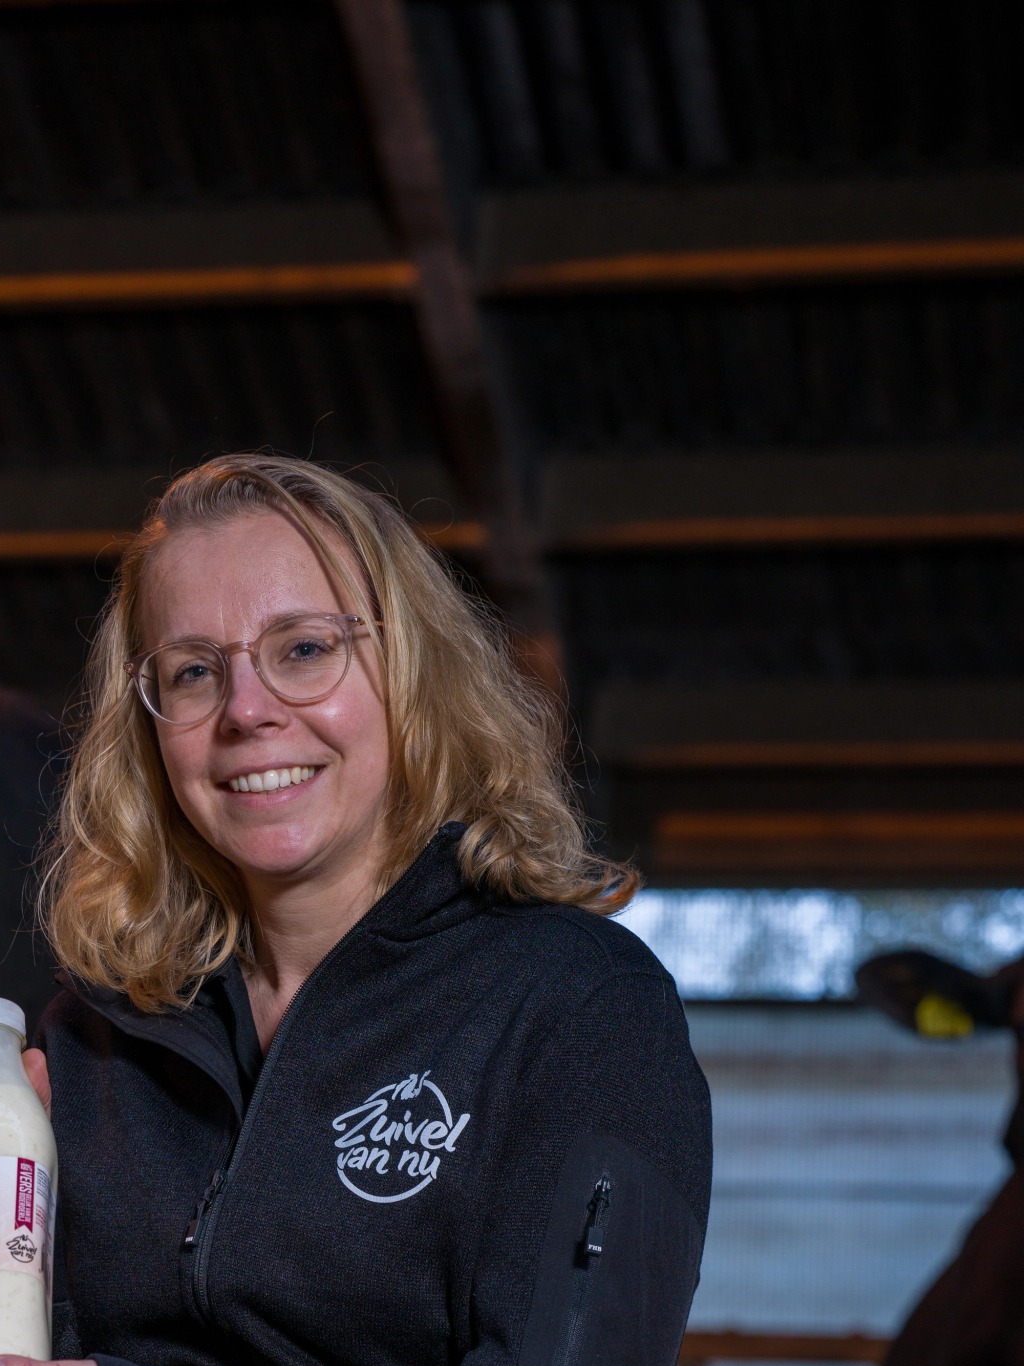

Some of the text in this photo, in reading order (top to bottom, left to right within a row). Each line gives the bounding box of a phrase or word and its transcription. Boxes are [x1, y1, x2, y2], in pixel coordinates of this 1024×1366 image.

[332, 1099, 470, 1153] Zuivel
[337, 1146, 441, 1179] van nu
[19, 1171, 33, 1194] VERS
[17, 1192, 26, 1222] BOERDERIJ
[6, 1239, 37, 1255] Zuivel
